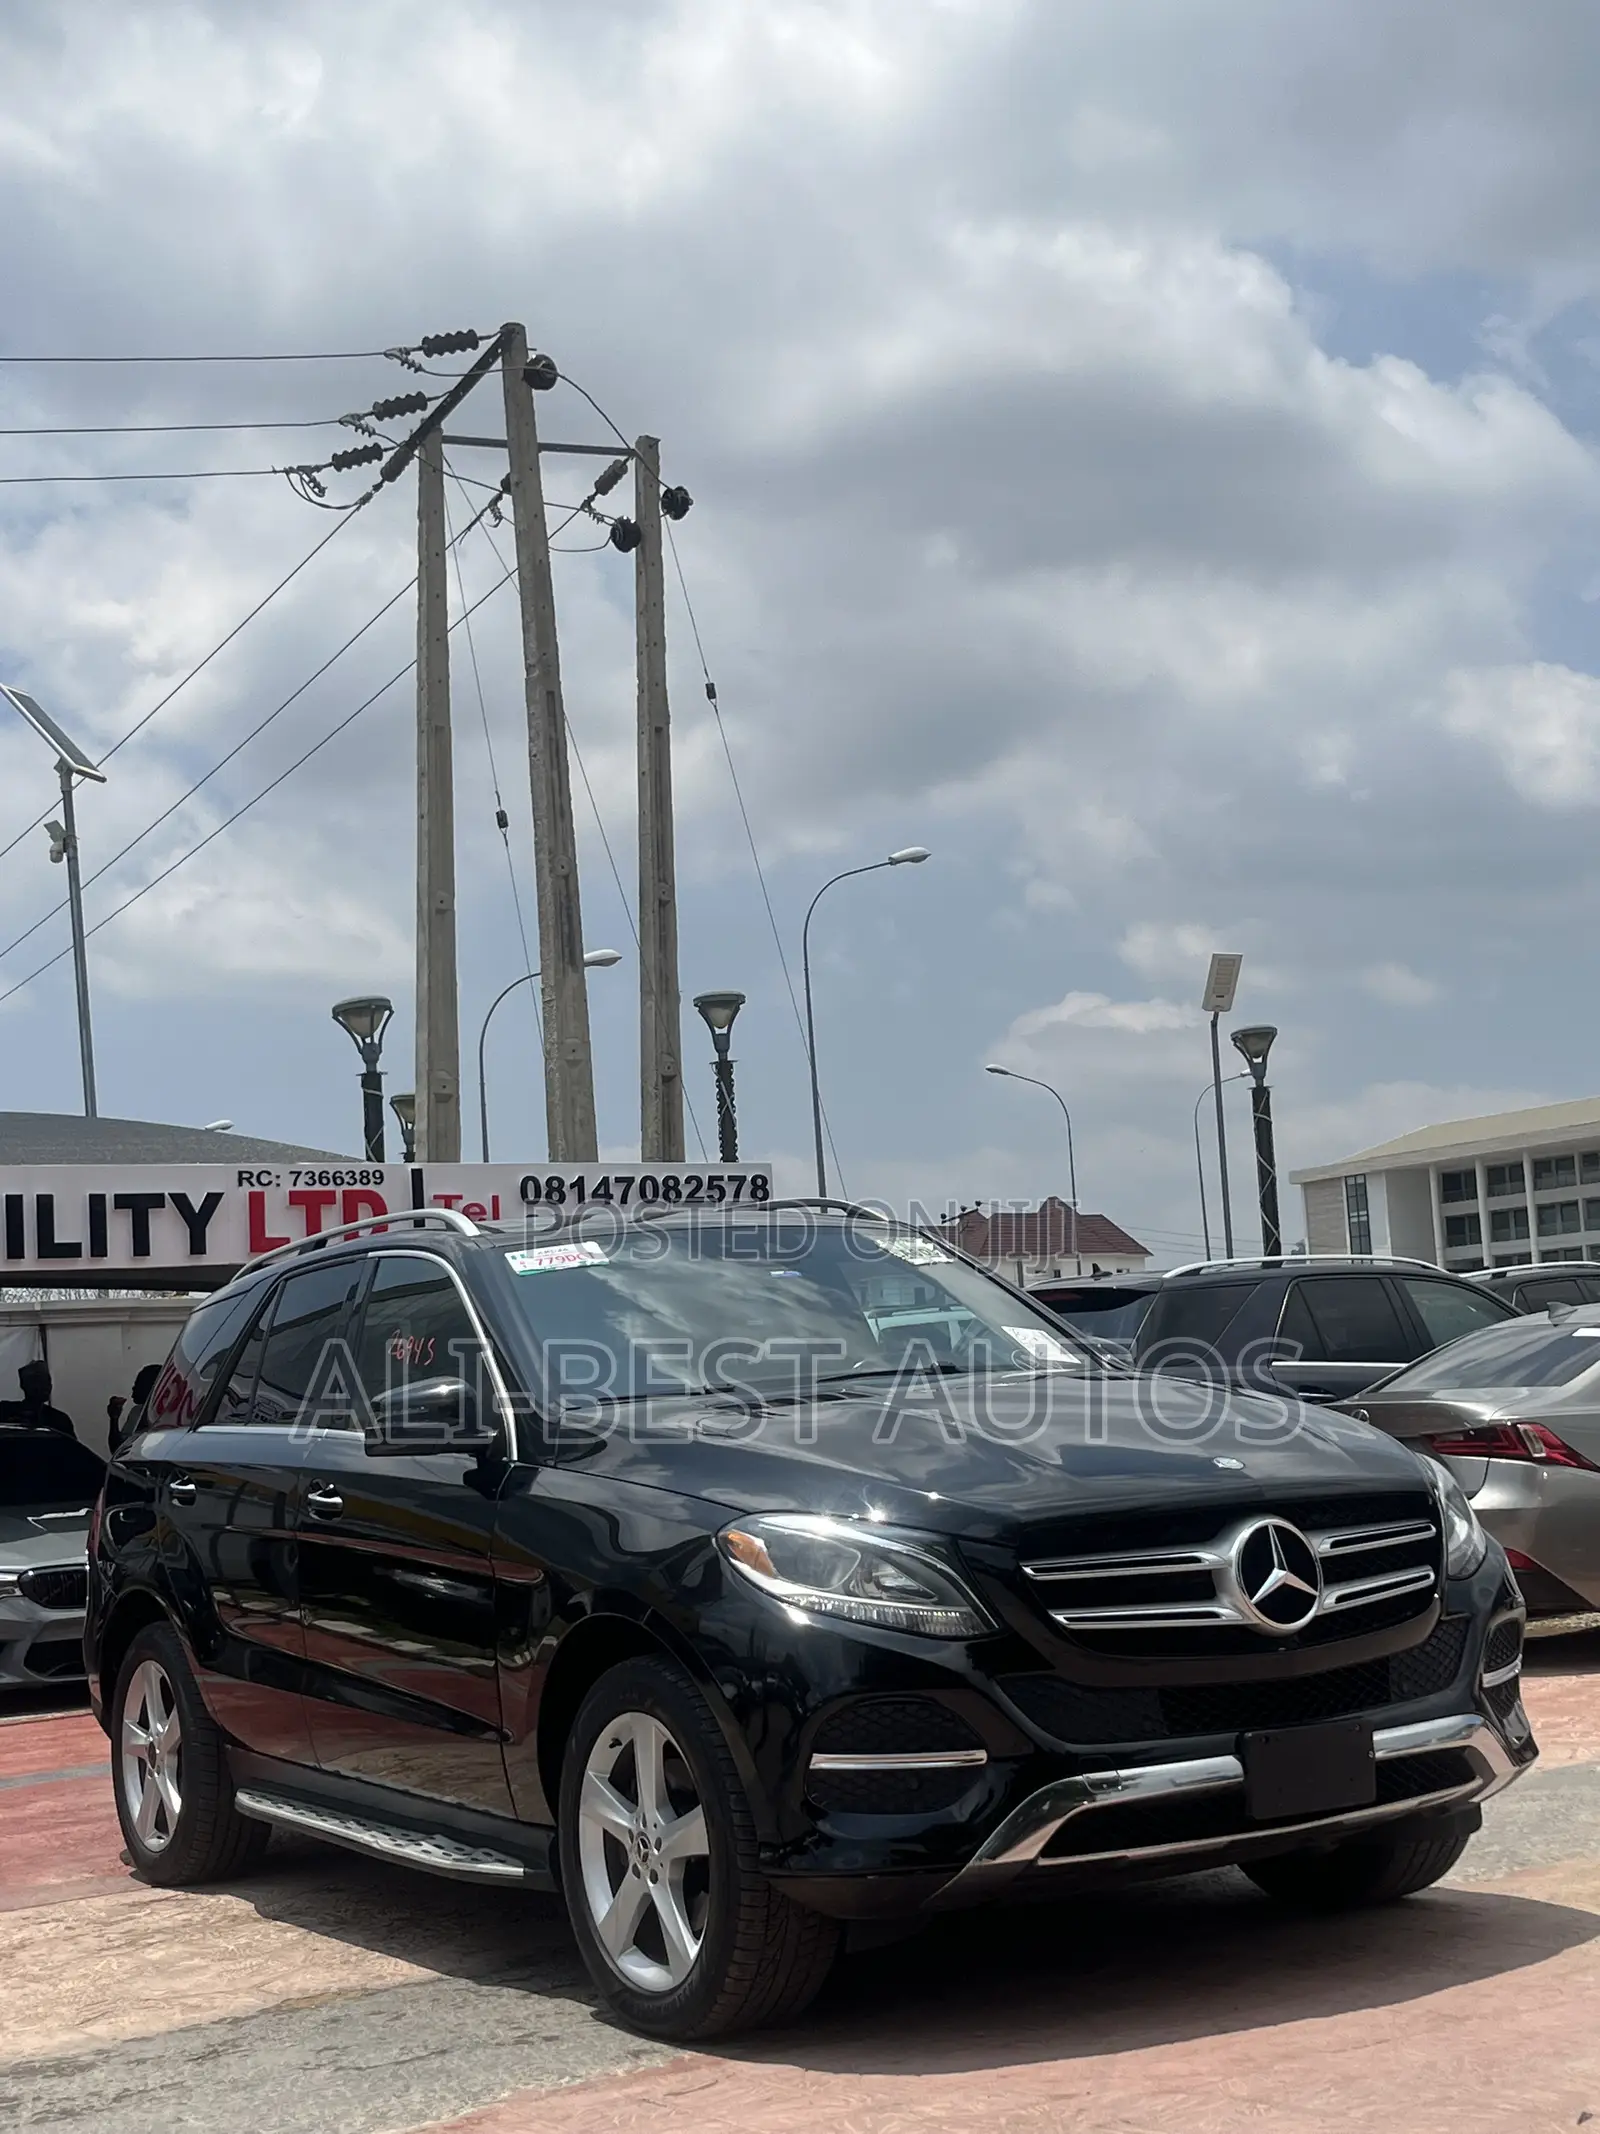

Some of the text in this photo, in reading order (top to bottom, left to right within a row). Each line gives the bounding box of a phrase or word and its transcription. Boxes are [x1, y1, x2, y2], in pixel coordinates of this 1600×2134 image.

[237, 1169, 385, 1188] RC: 7366389
[520, 1174, 770, 1205] 08147082578
[248, 1189, 389, 1253] LTD
